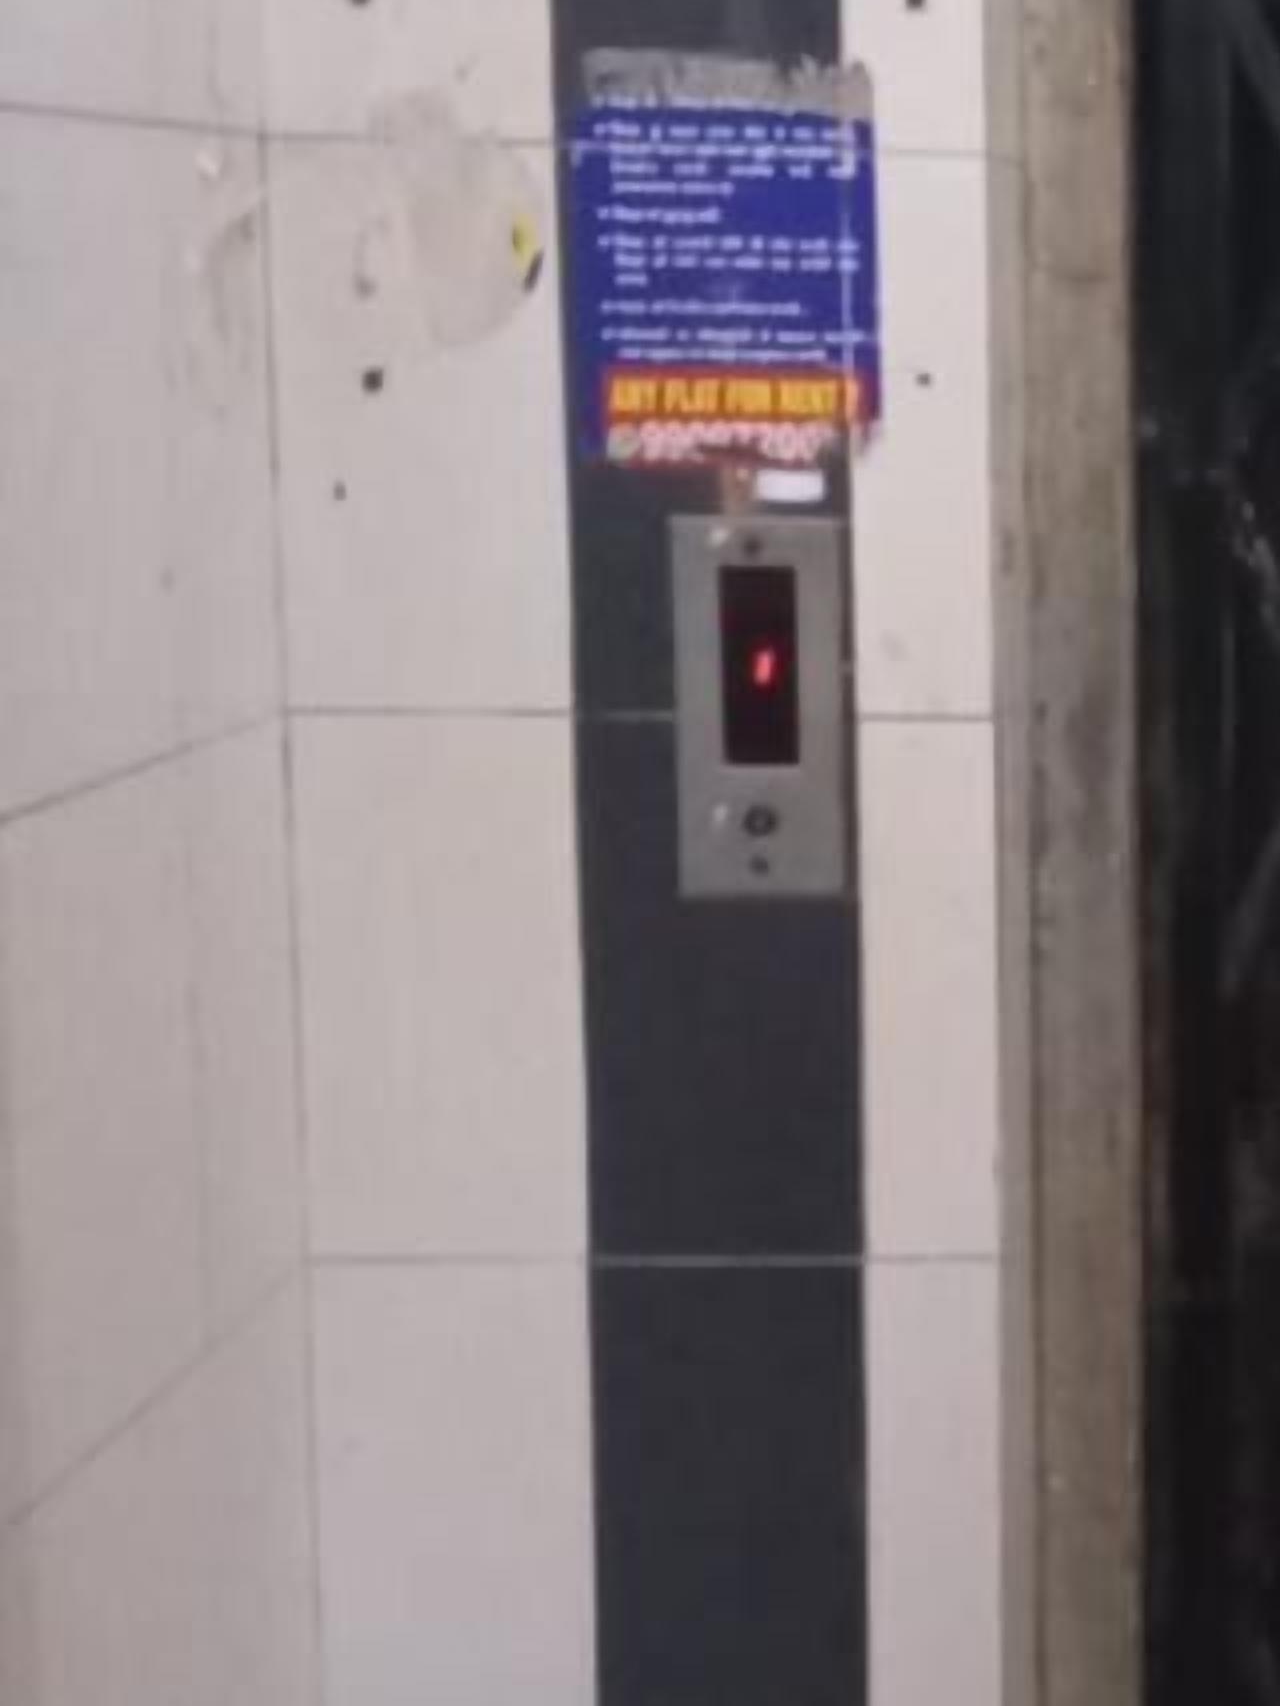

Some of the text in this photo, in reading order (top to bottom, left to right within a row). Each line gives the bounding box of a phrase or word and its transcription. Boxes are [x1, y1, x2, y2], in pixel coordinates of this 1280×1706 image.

[610, 375, 657, 414] ANY
[663, 375, 720, 414] FLAT
[724, 375, 771, 415] FOR
[778, 376, 837, 416] RENT
